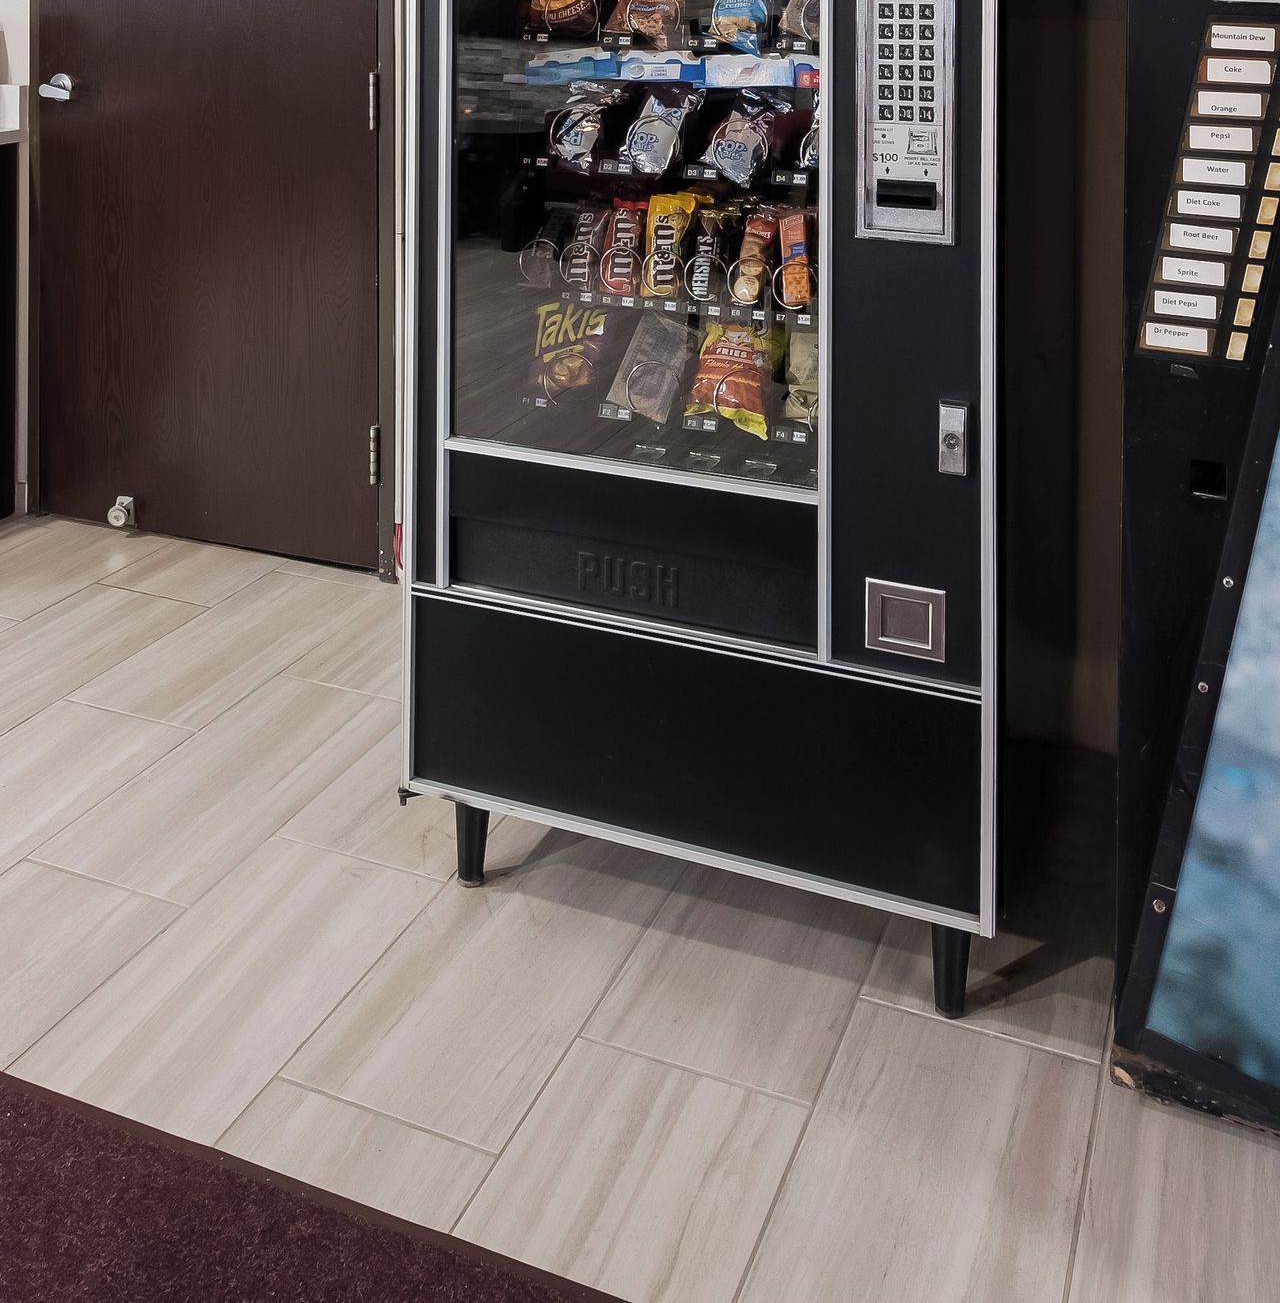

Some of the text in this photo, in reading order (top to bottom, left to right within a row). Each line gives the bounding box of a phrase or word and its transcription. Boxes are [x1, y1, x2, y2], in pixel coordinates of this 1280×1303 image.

[558, 0, 586, 19] CHEESE
[923, 70, 931, 78] 10
[923, 90, 931, 98] 12
[923, 110, 931, 118] 14
[872, 153, 898, 163] $1.00
[1177, 268, 1198, 277] Sprite
[1178, 299, 1197, 308] Pepsi
[535, 302, 607, 357] Takis
[1164, 328, 1189, 337] Pepper
[716, 348, 747, 358] FRIES
[578, 550, 679, 608] PUSH
